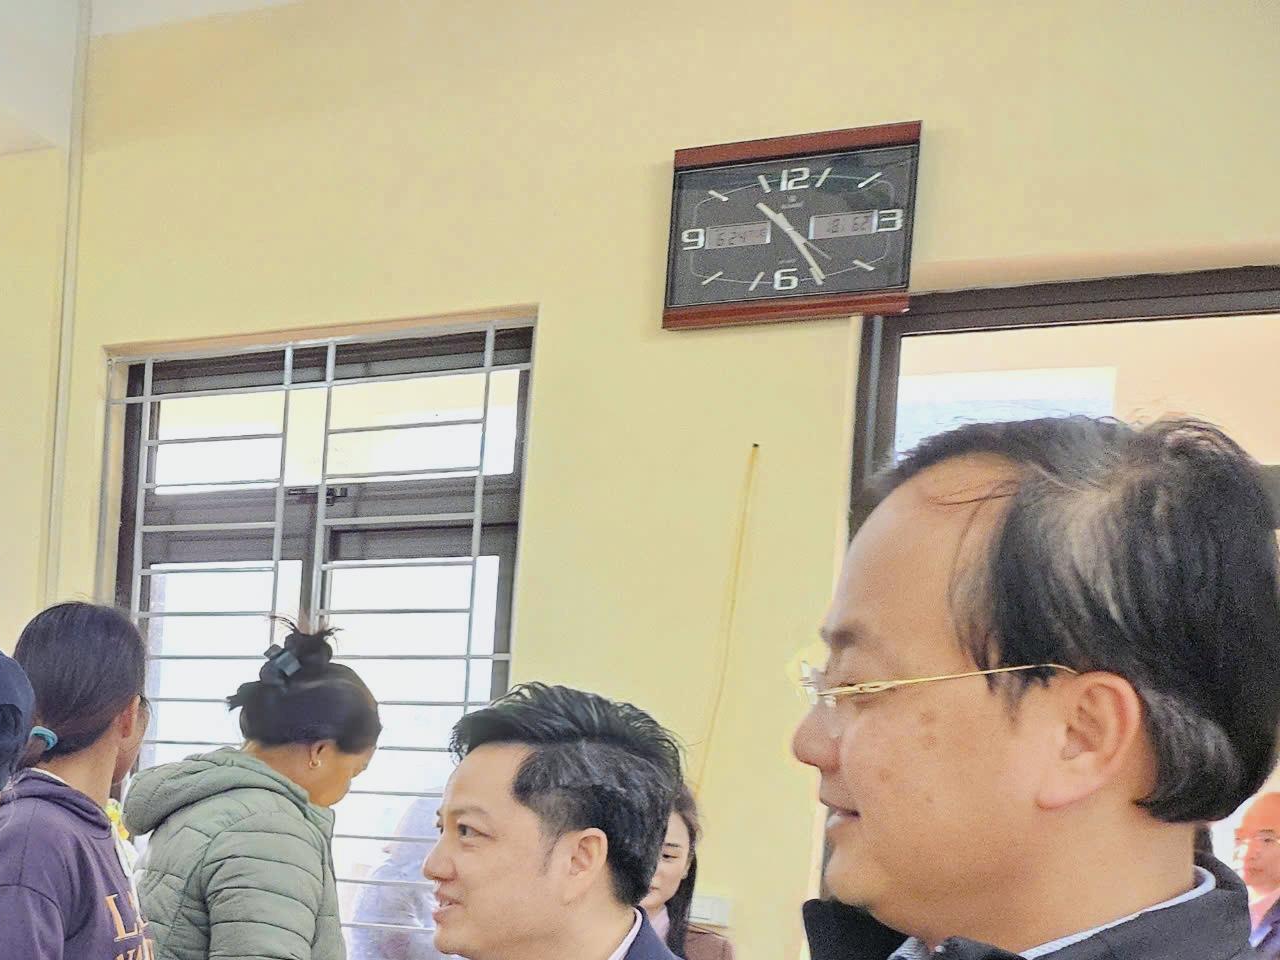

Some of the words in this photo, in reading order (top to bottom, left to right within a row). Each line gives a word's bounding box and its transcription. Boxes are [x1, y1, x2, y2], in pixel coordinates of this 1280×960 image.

[779, 167, 810, 191] 12
[877, 208, 904, 232] 3
[681, 228, 705, 250] 9
[773, 267, 799, 290] 6
